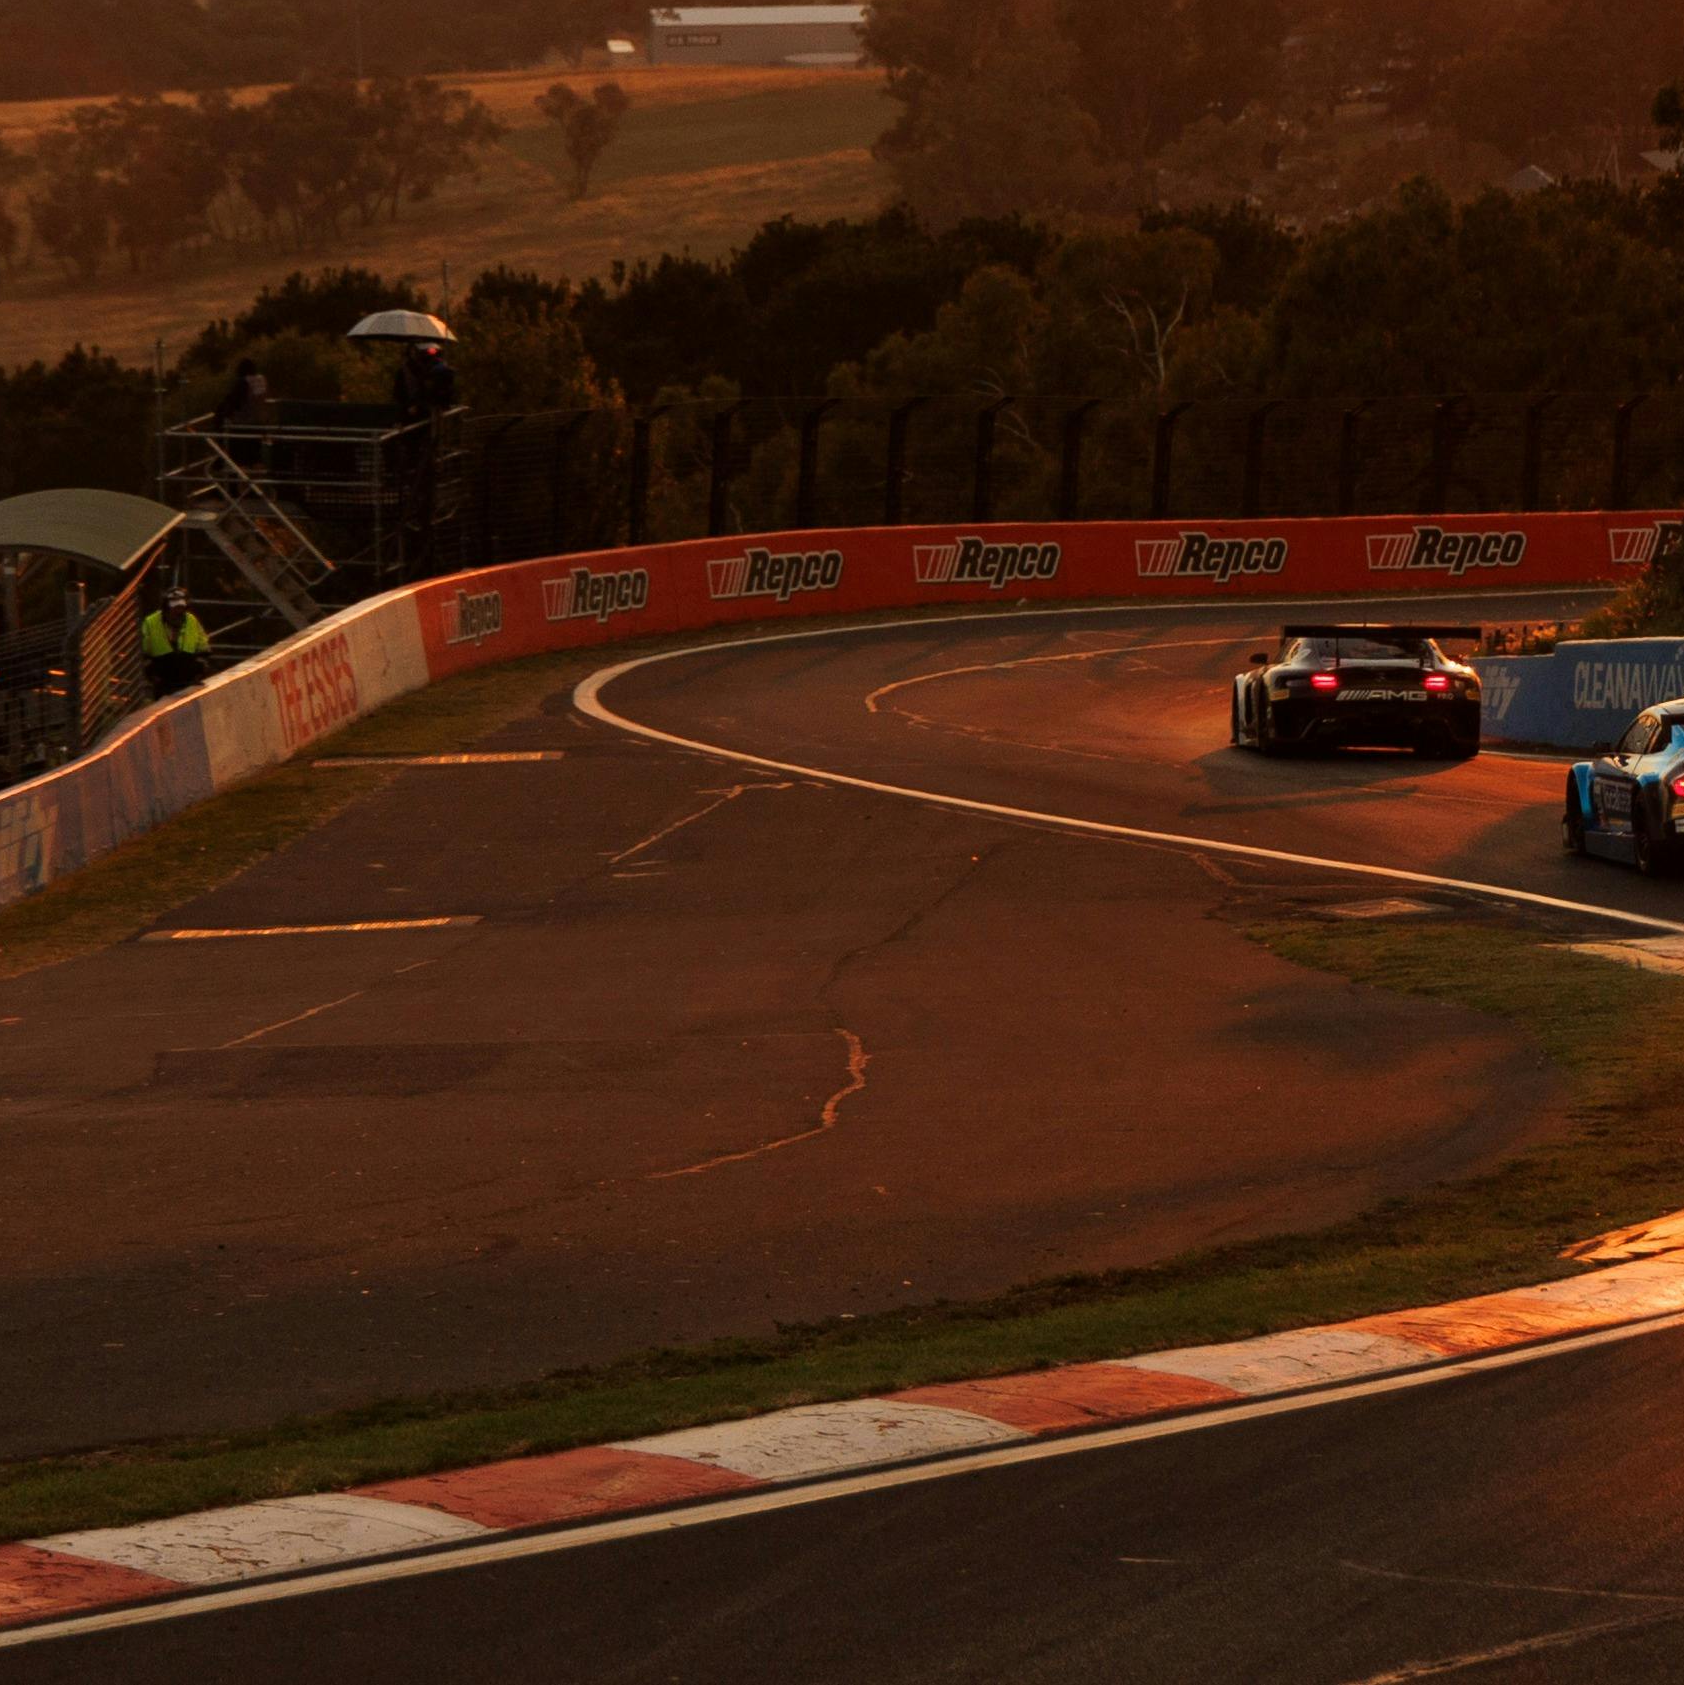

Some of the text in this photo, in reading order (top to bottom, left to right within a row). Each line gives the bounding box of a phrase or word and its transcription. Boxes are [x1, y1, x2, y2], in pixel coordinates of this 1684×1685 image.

[744, 547, 843, 601] Repco
[950, 536, 1062, 589] Repco
[1174, 531, 1287, 582] Repco
[1406, 526, 1526, 575] Repco
[570, 568, 648, 623] Repco
[269, 631, 359, 750] THE ESSES
[1367, 689, 1428, 702] AMG
